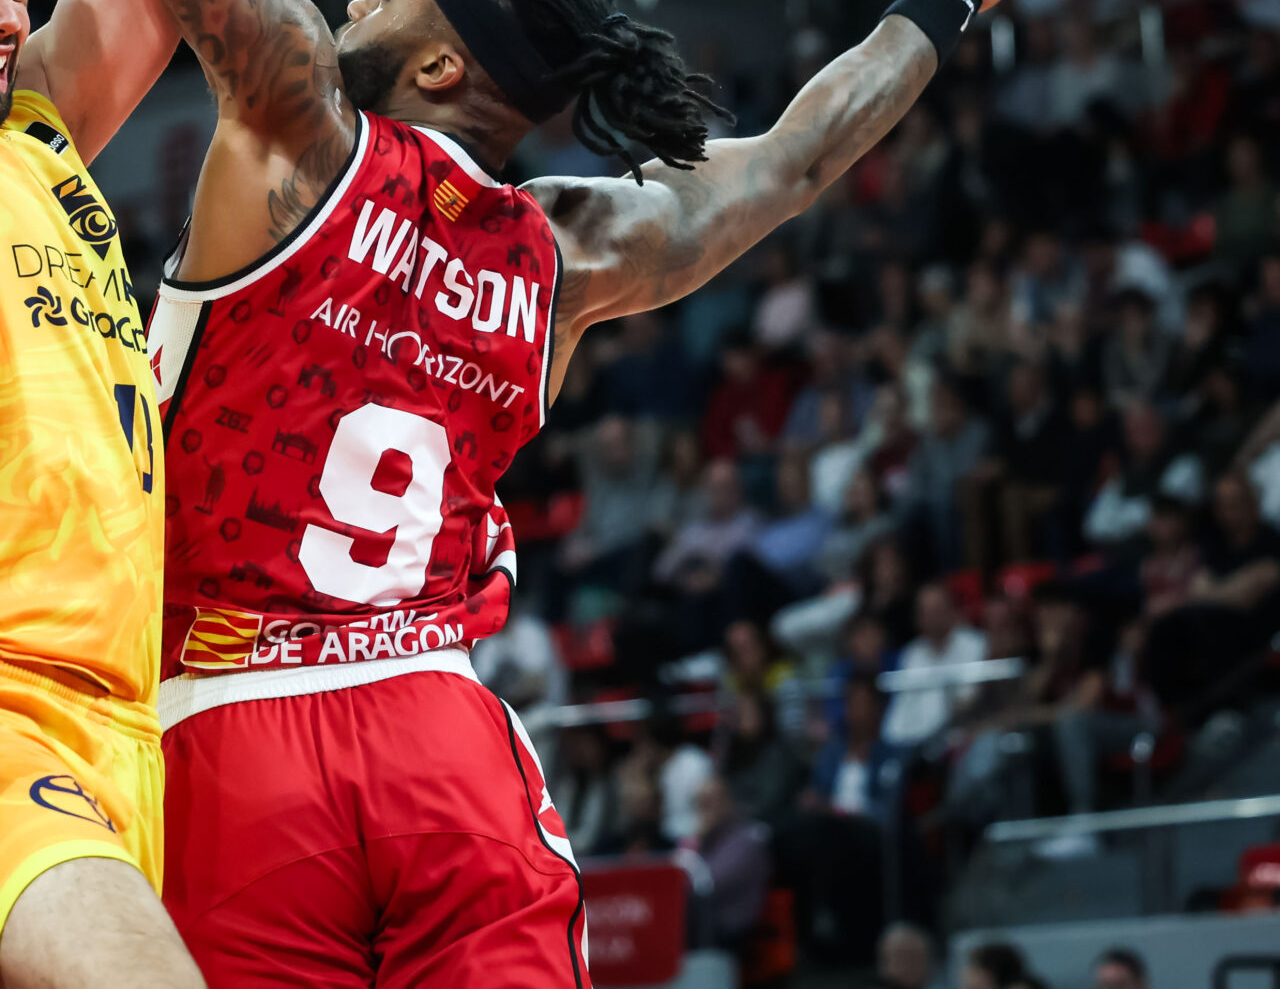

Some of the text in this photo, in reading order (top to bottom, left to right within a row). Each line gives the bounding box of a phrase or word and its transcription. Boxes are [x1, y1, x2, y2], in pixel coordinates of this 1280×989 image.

[347, 199, 540, 344] WATSON
[310, 297, 526, 409] AIR HORIZONT
[298, 402, 451, 607] 9
[251, 623, 464, 664] DE ARAGON
